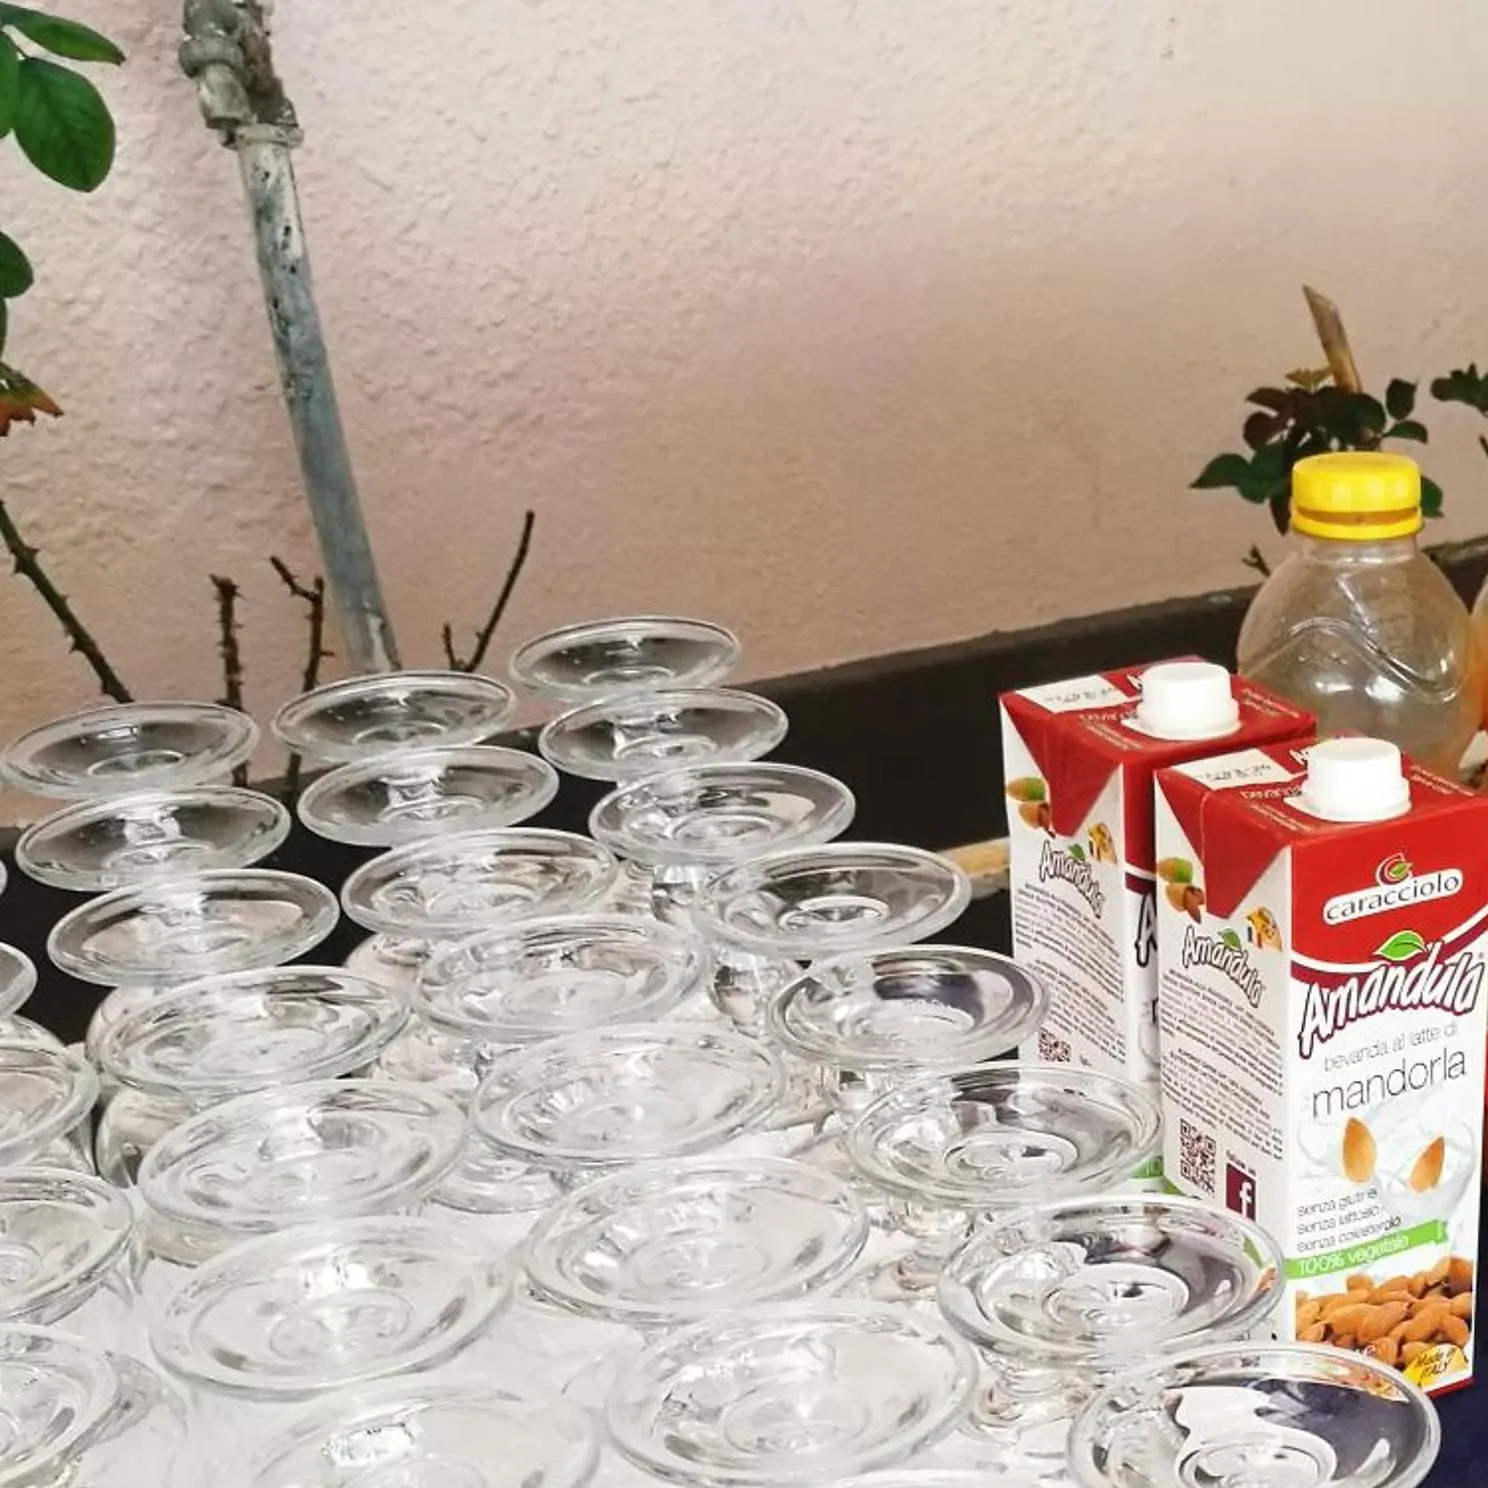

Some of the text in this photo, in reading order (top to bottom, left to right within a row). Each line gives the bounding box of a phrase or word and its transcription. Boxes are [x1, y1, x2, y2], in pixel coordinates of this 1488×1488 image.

[1326, 872, 1459, 921] caracciolo
[1181, 925, 1265, 1008] Amandula
[1298, 938, 1485, 1059] Amandula
[1313, 1047, 1466, 1118] mandorla
[1296, 1252, 1345, 1275] 100%
